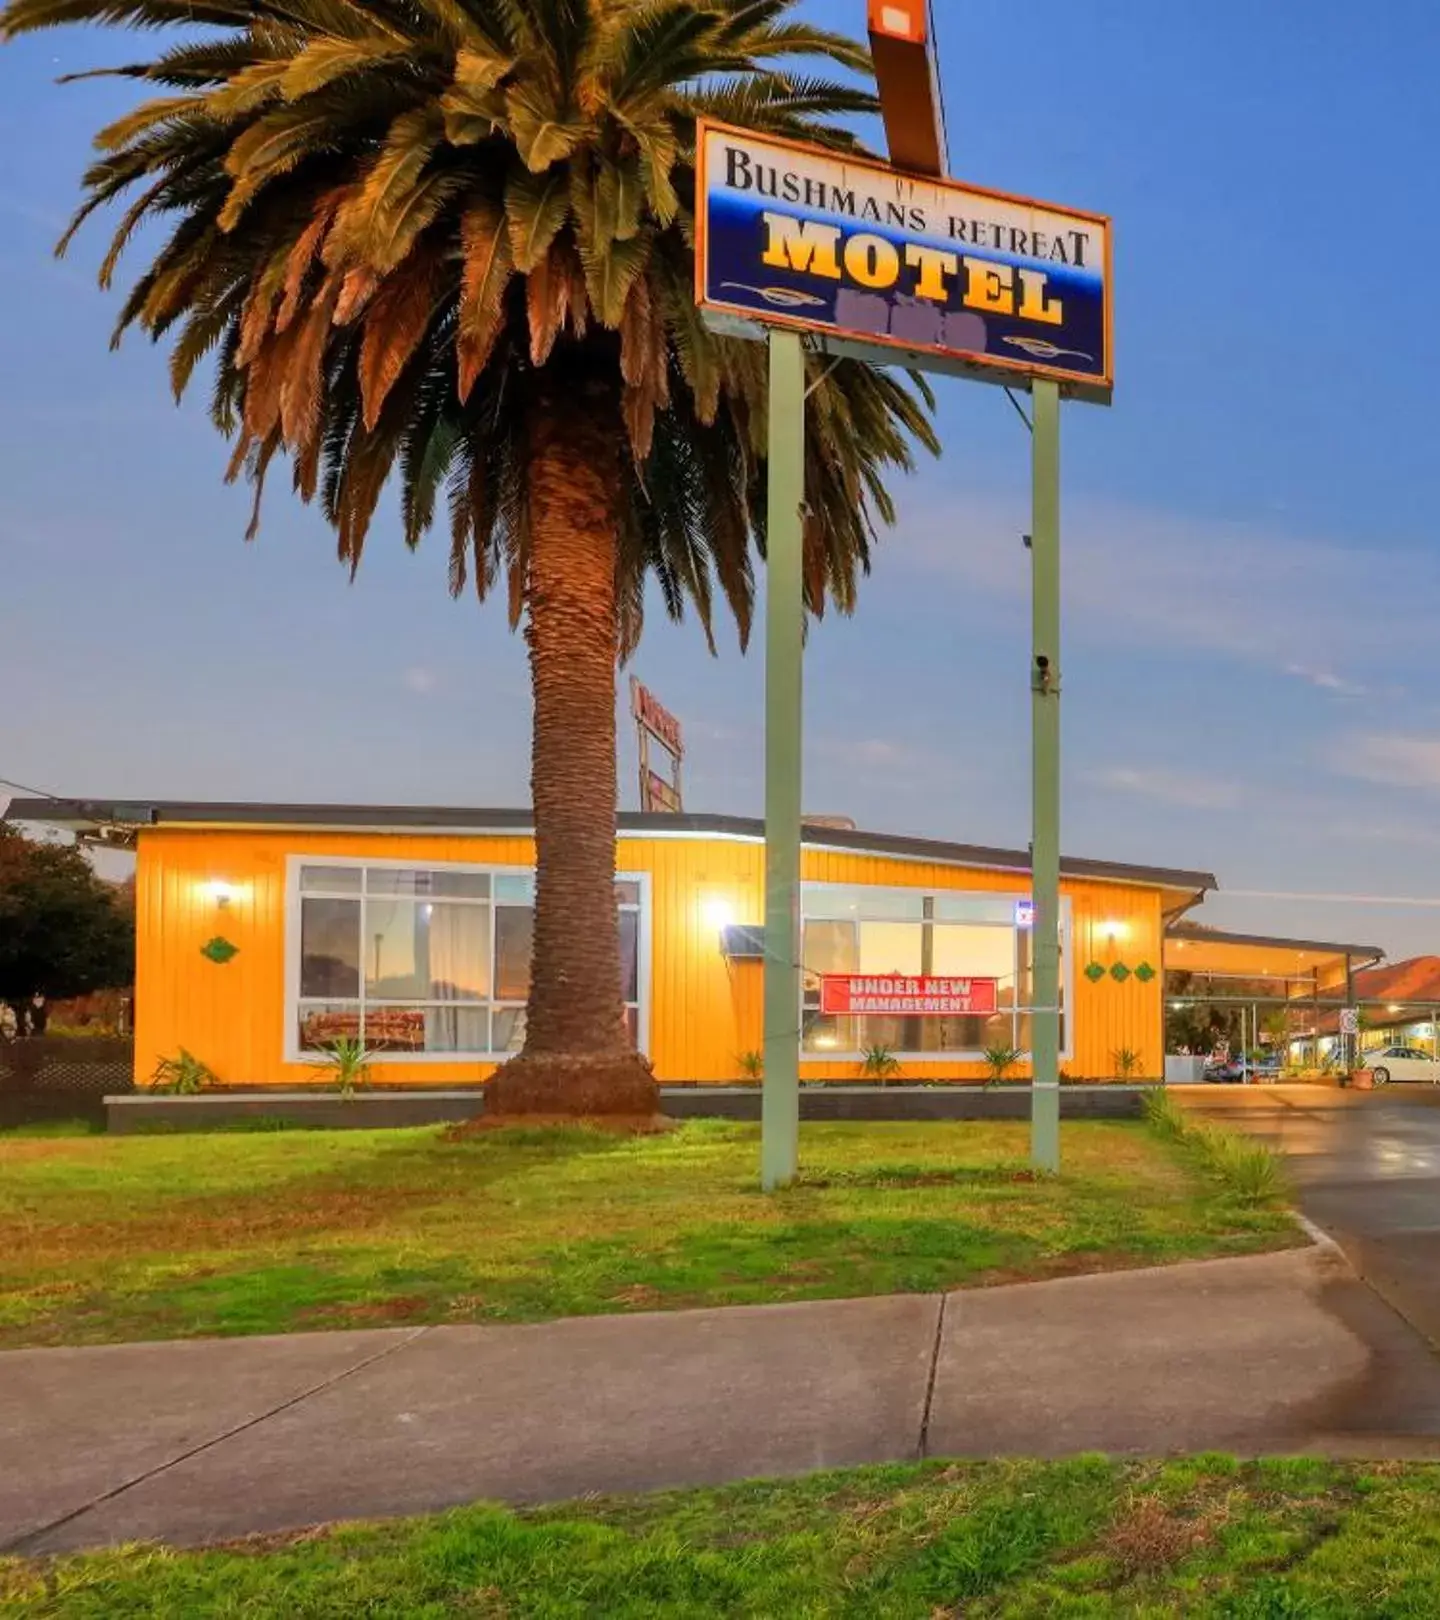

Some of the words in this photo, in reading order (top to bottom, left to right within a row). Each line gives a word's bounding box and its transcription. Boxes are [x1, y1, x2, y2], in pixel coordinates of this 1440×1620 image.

[725, 146, 927, 232] BUSHMANS
[949, 216, 1090, 267] RETREAT
[762, 211, 1064, 326] MOTEL
[850, 979, 918, 995] UNDER
[924, 979, 972, 995] NEW
[850, 996, 972, 1010] MANAGEMENT
